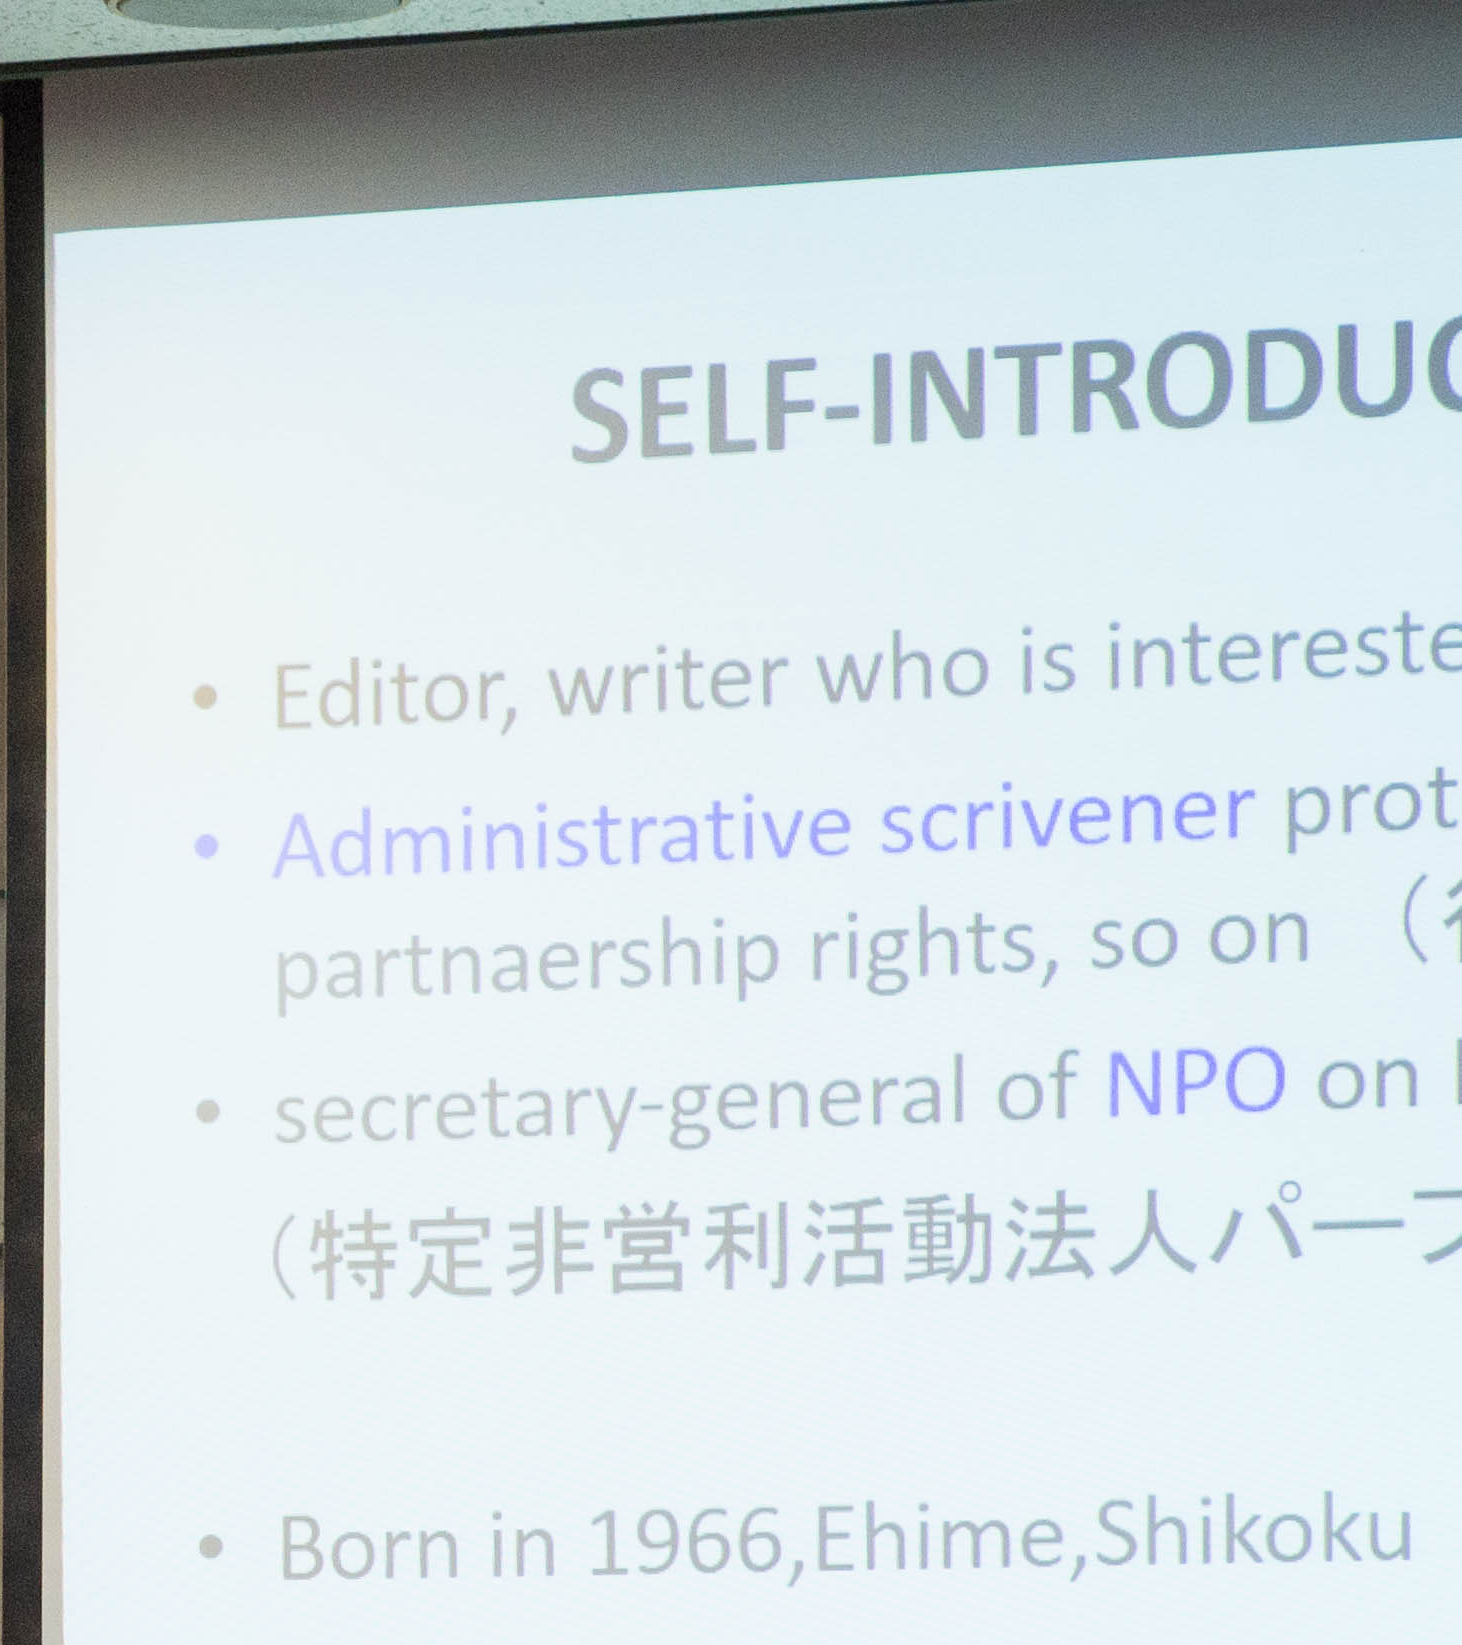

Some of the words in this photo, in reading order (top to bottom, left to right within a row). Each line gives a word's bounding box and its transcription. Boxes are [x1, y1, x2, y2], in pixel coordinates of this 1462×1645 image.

[275, 655, 520, 738] Editor,
[546, 638, 793, 720] writer
[814, 627, 993, 707] who
[1018, 623, 1079, 698] is
[1106, 608, 1462, 696] intereste
[270, 790, 855, 881] Administrative
[879, 779, 1259, 857] scrivener
[1285, 764, 1461, 857] prot
[276, 908, 782, 1020] partnaership
[811, 902, 1062, 1001] rights,
[1089, 915, 1180, 972] so
[1207, 910, 1312, 967] on
[274, 1051, 967, 1155] secretary-general
[995, 1046, 1082, 1123] of
[1107, 1043, 1288, 1120] NPO
[1315, 1056, 1420, 1112] on
[280, 1513, 461, 1582] Born
[490, 1509, 557, 1579] in
[589, 1488, 1414, 1590] 1966,Ehime,Shikoku
